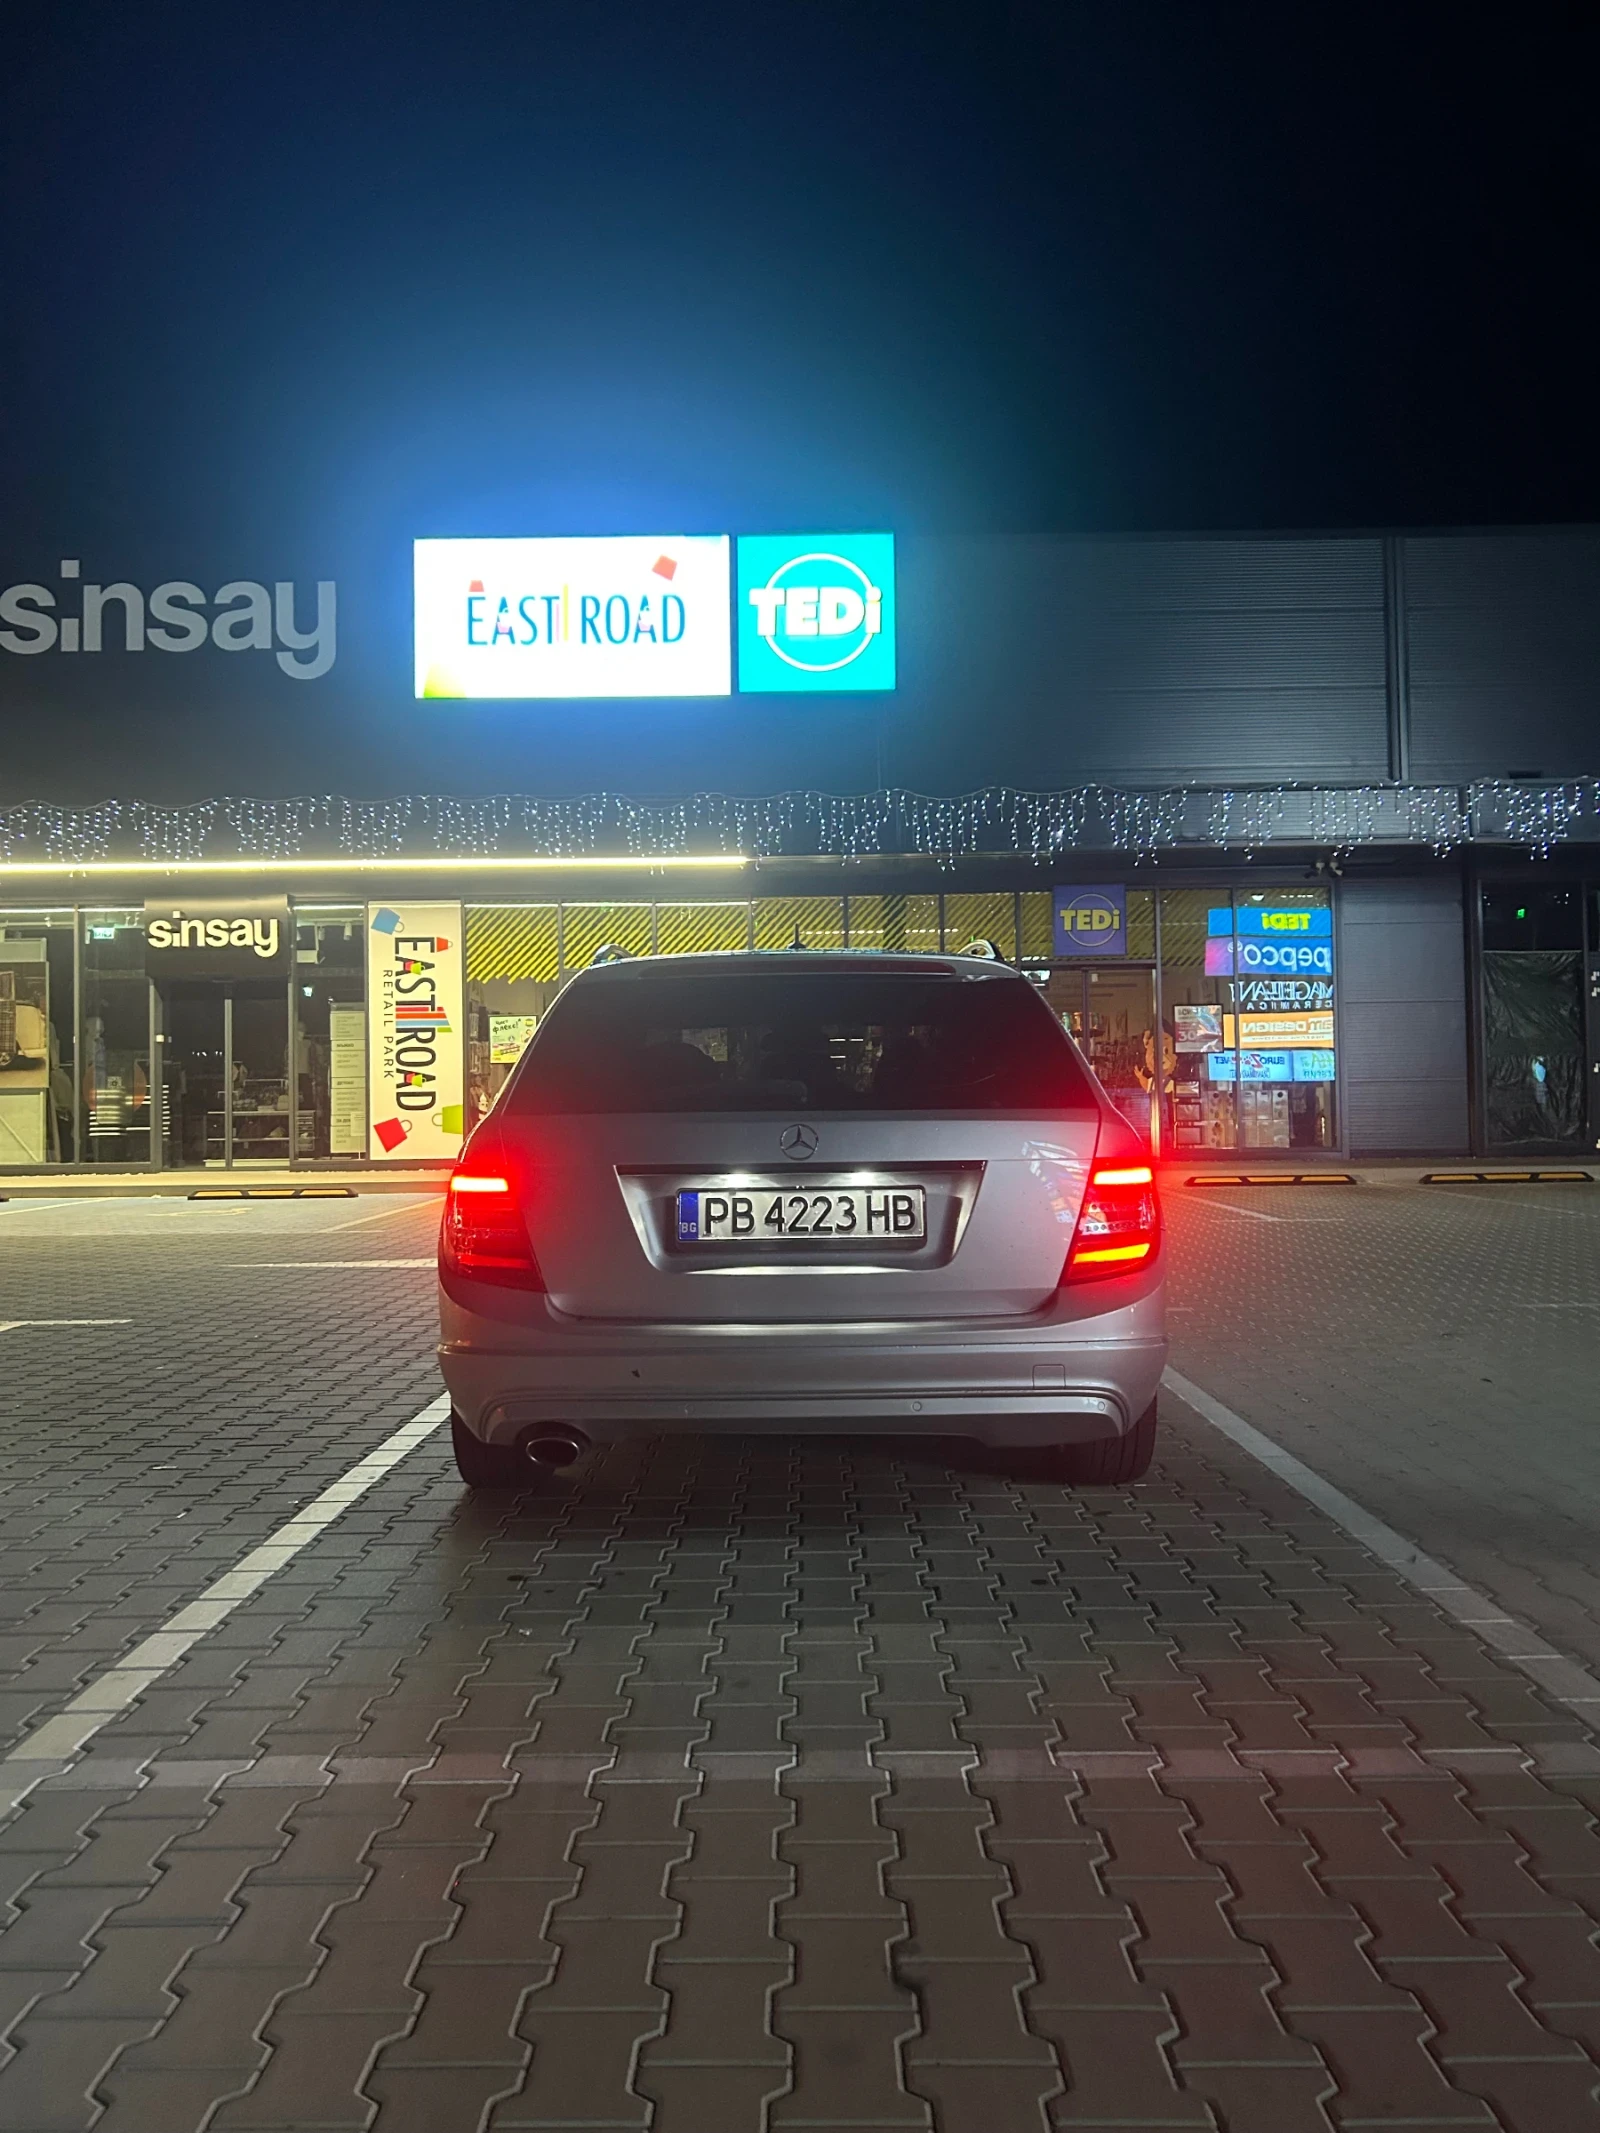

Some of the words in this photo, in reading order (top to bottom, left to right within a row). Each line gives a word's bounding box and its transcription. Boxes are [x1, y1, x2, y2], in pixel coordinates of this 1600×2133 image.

[0, 559, 336, 680] sinsay
[467, 591, 560, 646] EAST
[580, 591, 686, 646] ROAD
[749, 586, 882, 637] TEDi
[148, 911, 278, 958] sinsay
[1060, 908, 1120, 931] TEDi
[382, 969, 394, 1027] RETAIL
[394, 937, 436, 1012] EAST
[383, 1036, 394, 1078] PARK
[395, 1027, 436, 1111] ROAD
[681, 1222, 697, 1233] BG
[704, 1197, 755, 1234] PB
[764, 1196, 857, 1233] 4223
[866, 1195, 916, 1231] HB
